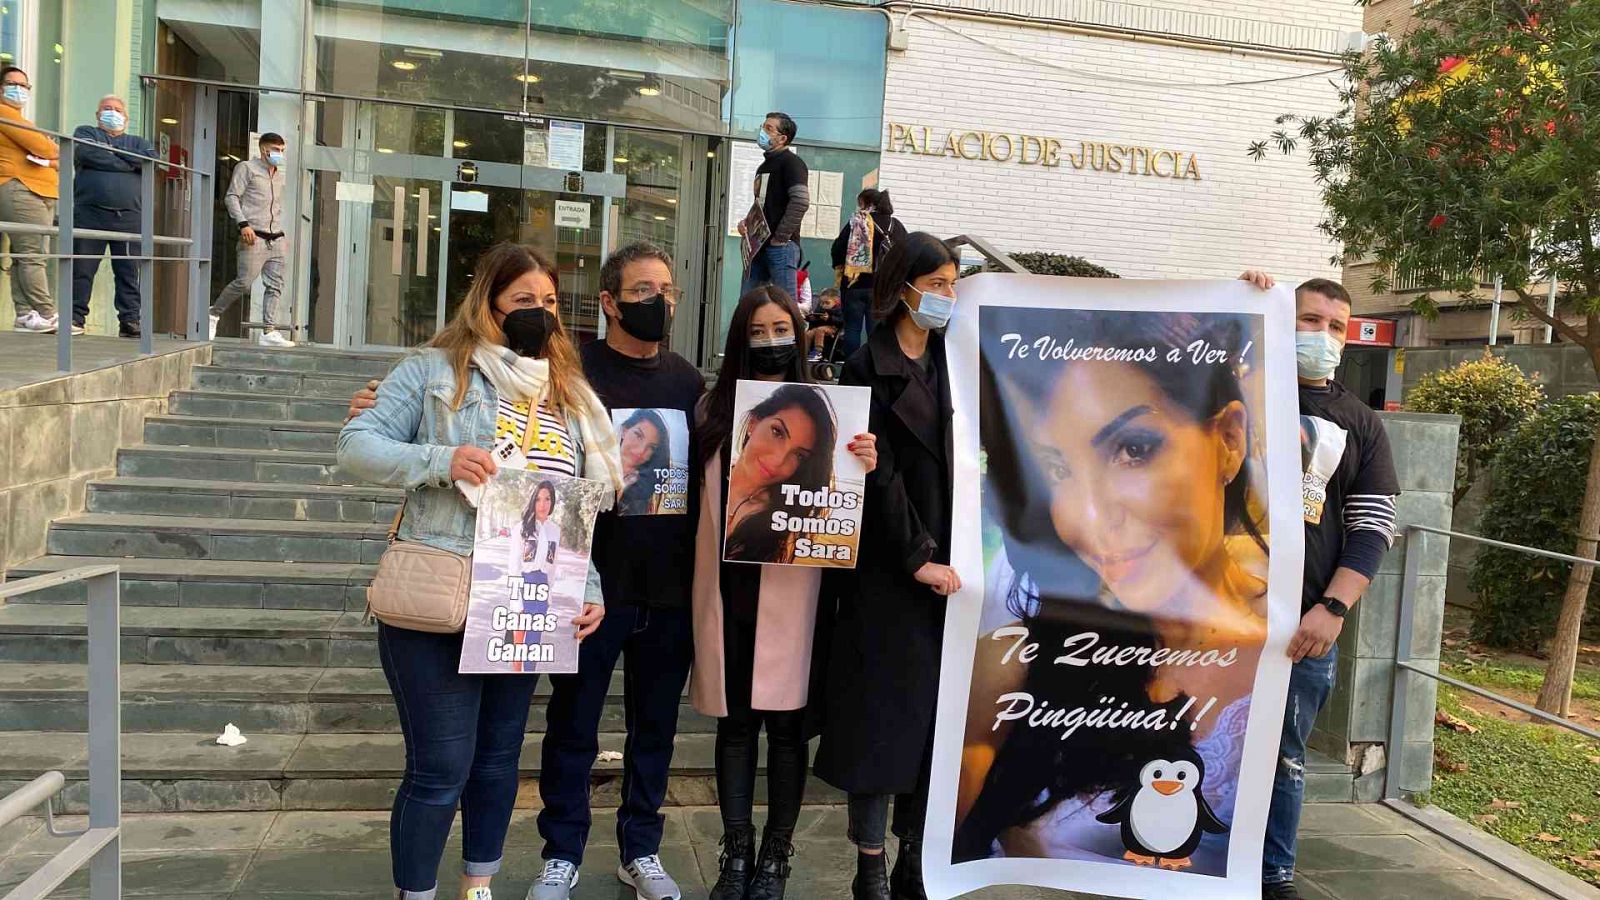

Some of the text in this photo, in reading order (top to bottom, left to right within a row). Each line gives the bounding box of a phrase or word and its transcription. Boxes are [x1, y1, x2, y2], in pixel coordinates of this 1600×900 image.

[887, 122, 1202, 181] PALACIO DE JUSTICIA
[558, 205, 585, 213] ENTRADA
[1000, 333, 1030, 360] Te
[1033, 335, 1157, 363] Volveremos
[1166, 348, 1182, 363] a
[1187, 339, 1228, 365] Ver
[653, 468, 687, 479] TODOS
[654, 483, 686, 494] SOMOS
[781, 484, 858, 509] Todos
[771, 510, 856, 536] Somos
[1303, 504, 1317, 517] RA
[794, 538, 852, 560] Sara
[507, 575, 550, 601] Tus
[491, 605, 559, 632] Ganas
[487, 636, 555, 663] Ganan
[992, 626, 1238, 668] Te Queremos
[991, 691, 1218, 741] Pingüina!!
